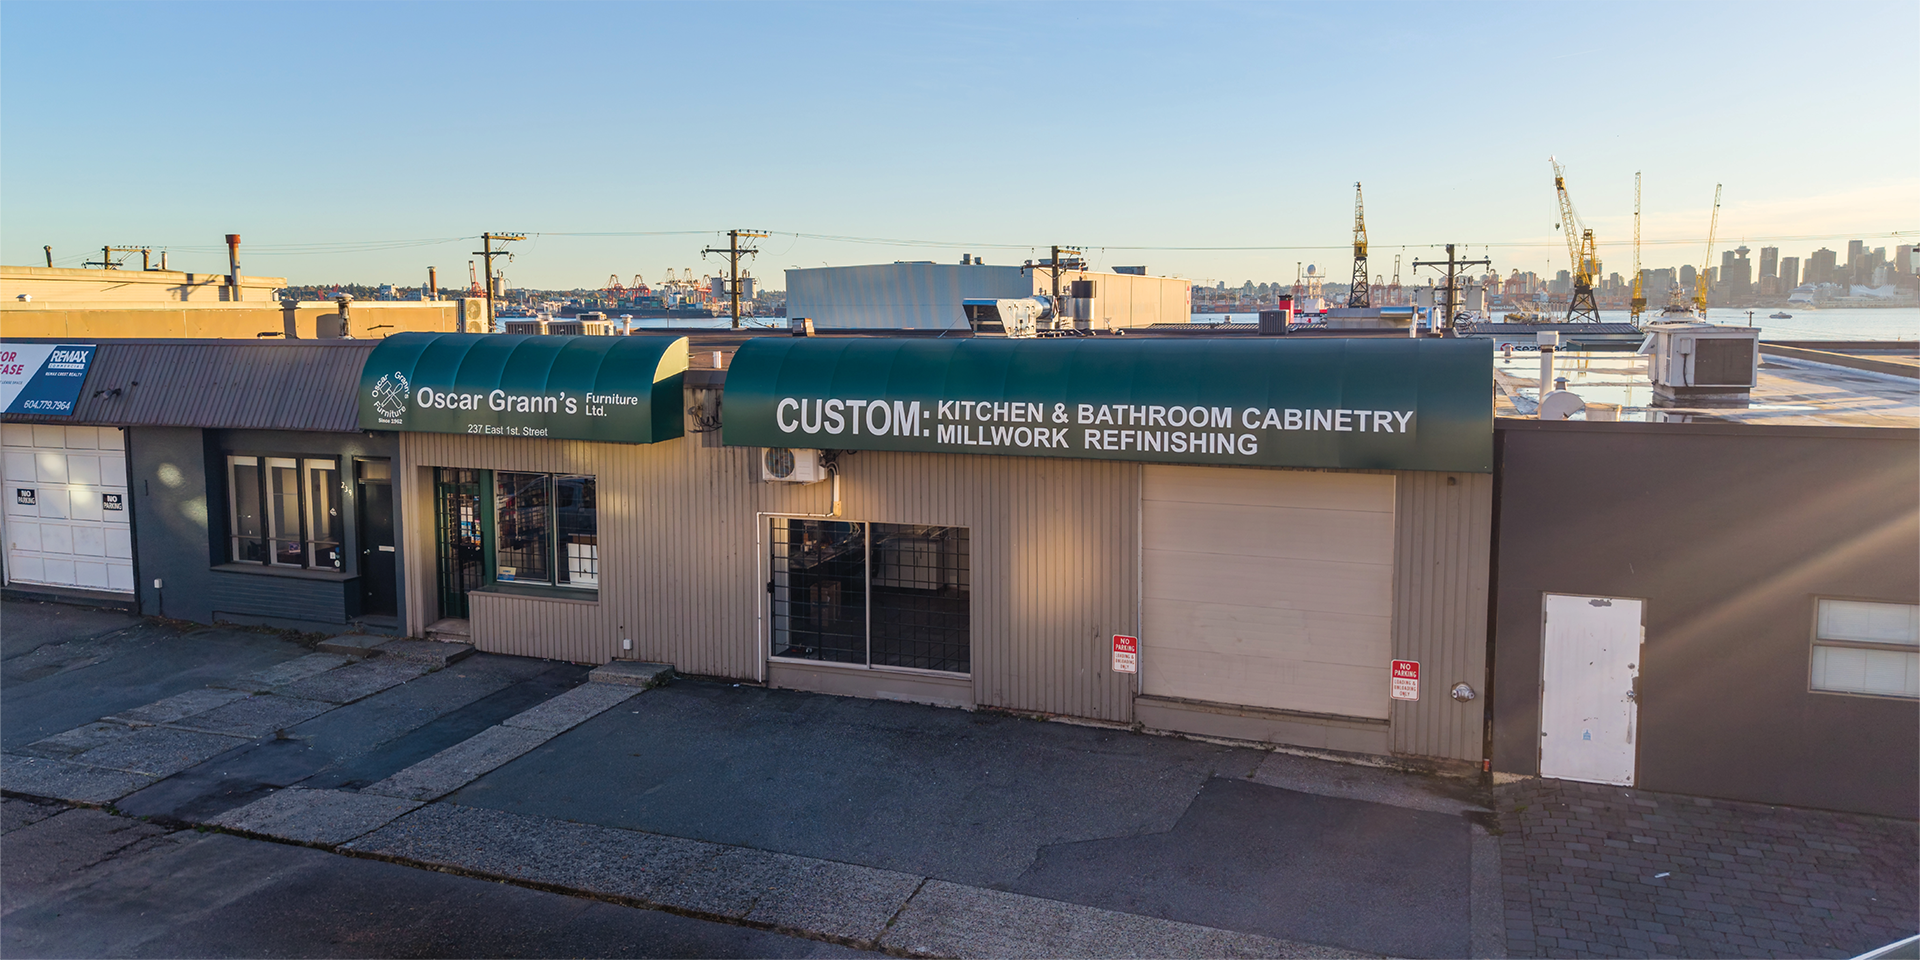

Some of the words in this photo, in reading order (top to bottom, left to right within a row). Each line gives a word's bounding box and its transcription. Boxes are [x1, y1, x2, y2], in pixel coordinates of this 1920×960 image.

[0, 351, 17, 362] OR
[372, 374, 389, 398] Oscar
[23, 400, 71, 411] 604.779.7964
[417, 386, 483, 411] Oscar
[488, 389, 578, 415] Grann's
[585, 392, 639, 406] Furniture
[373, 401, 407, 418] Furniture
[585, 405, 608, 417] Ltd.
[776, 397, 930, 437] CUSTOM:
[937, 400, 1044, 423] KITCHEN
[1051, 402, 1070, 425] &
[1077, 403, 1233, 429] BATHROOM
[1241, 407, 1414, 434] CABINETRY
[467, 424, 483, 434] 237
[485, 425, 504, 435] East
[522, 426, 548, 437] Street
[937, 424, 1070, 449] MILLWORK
[1084, 428, 1259, 455] REFINISHING
[103, 502, 122, 510] PARKING
[1394, 670, 1416, 678] PARKING
